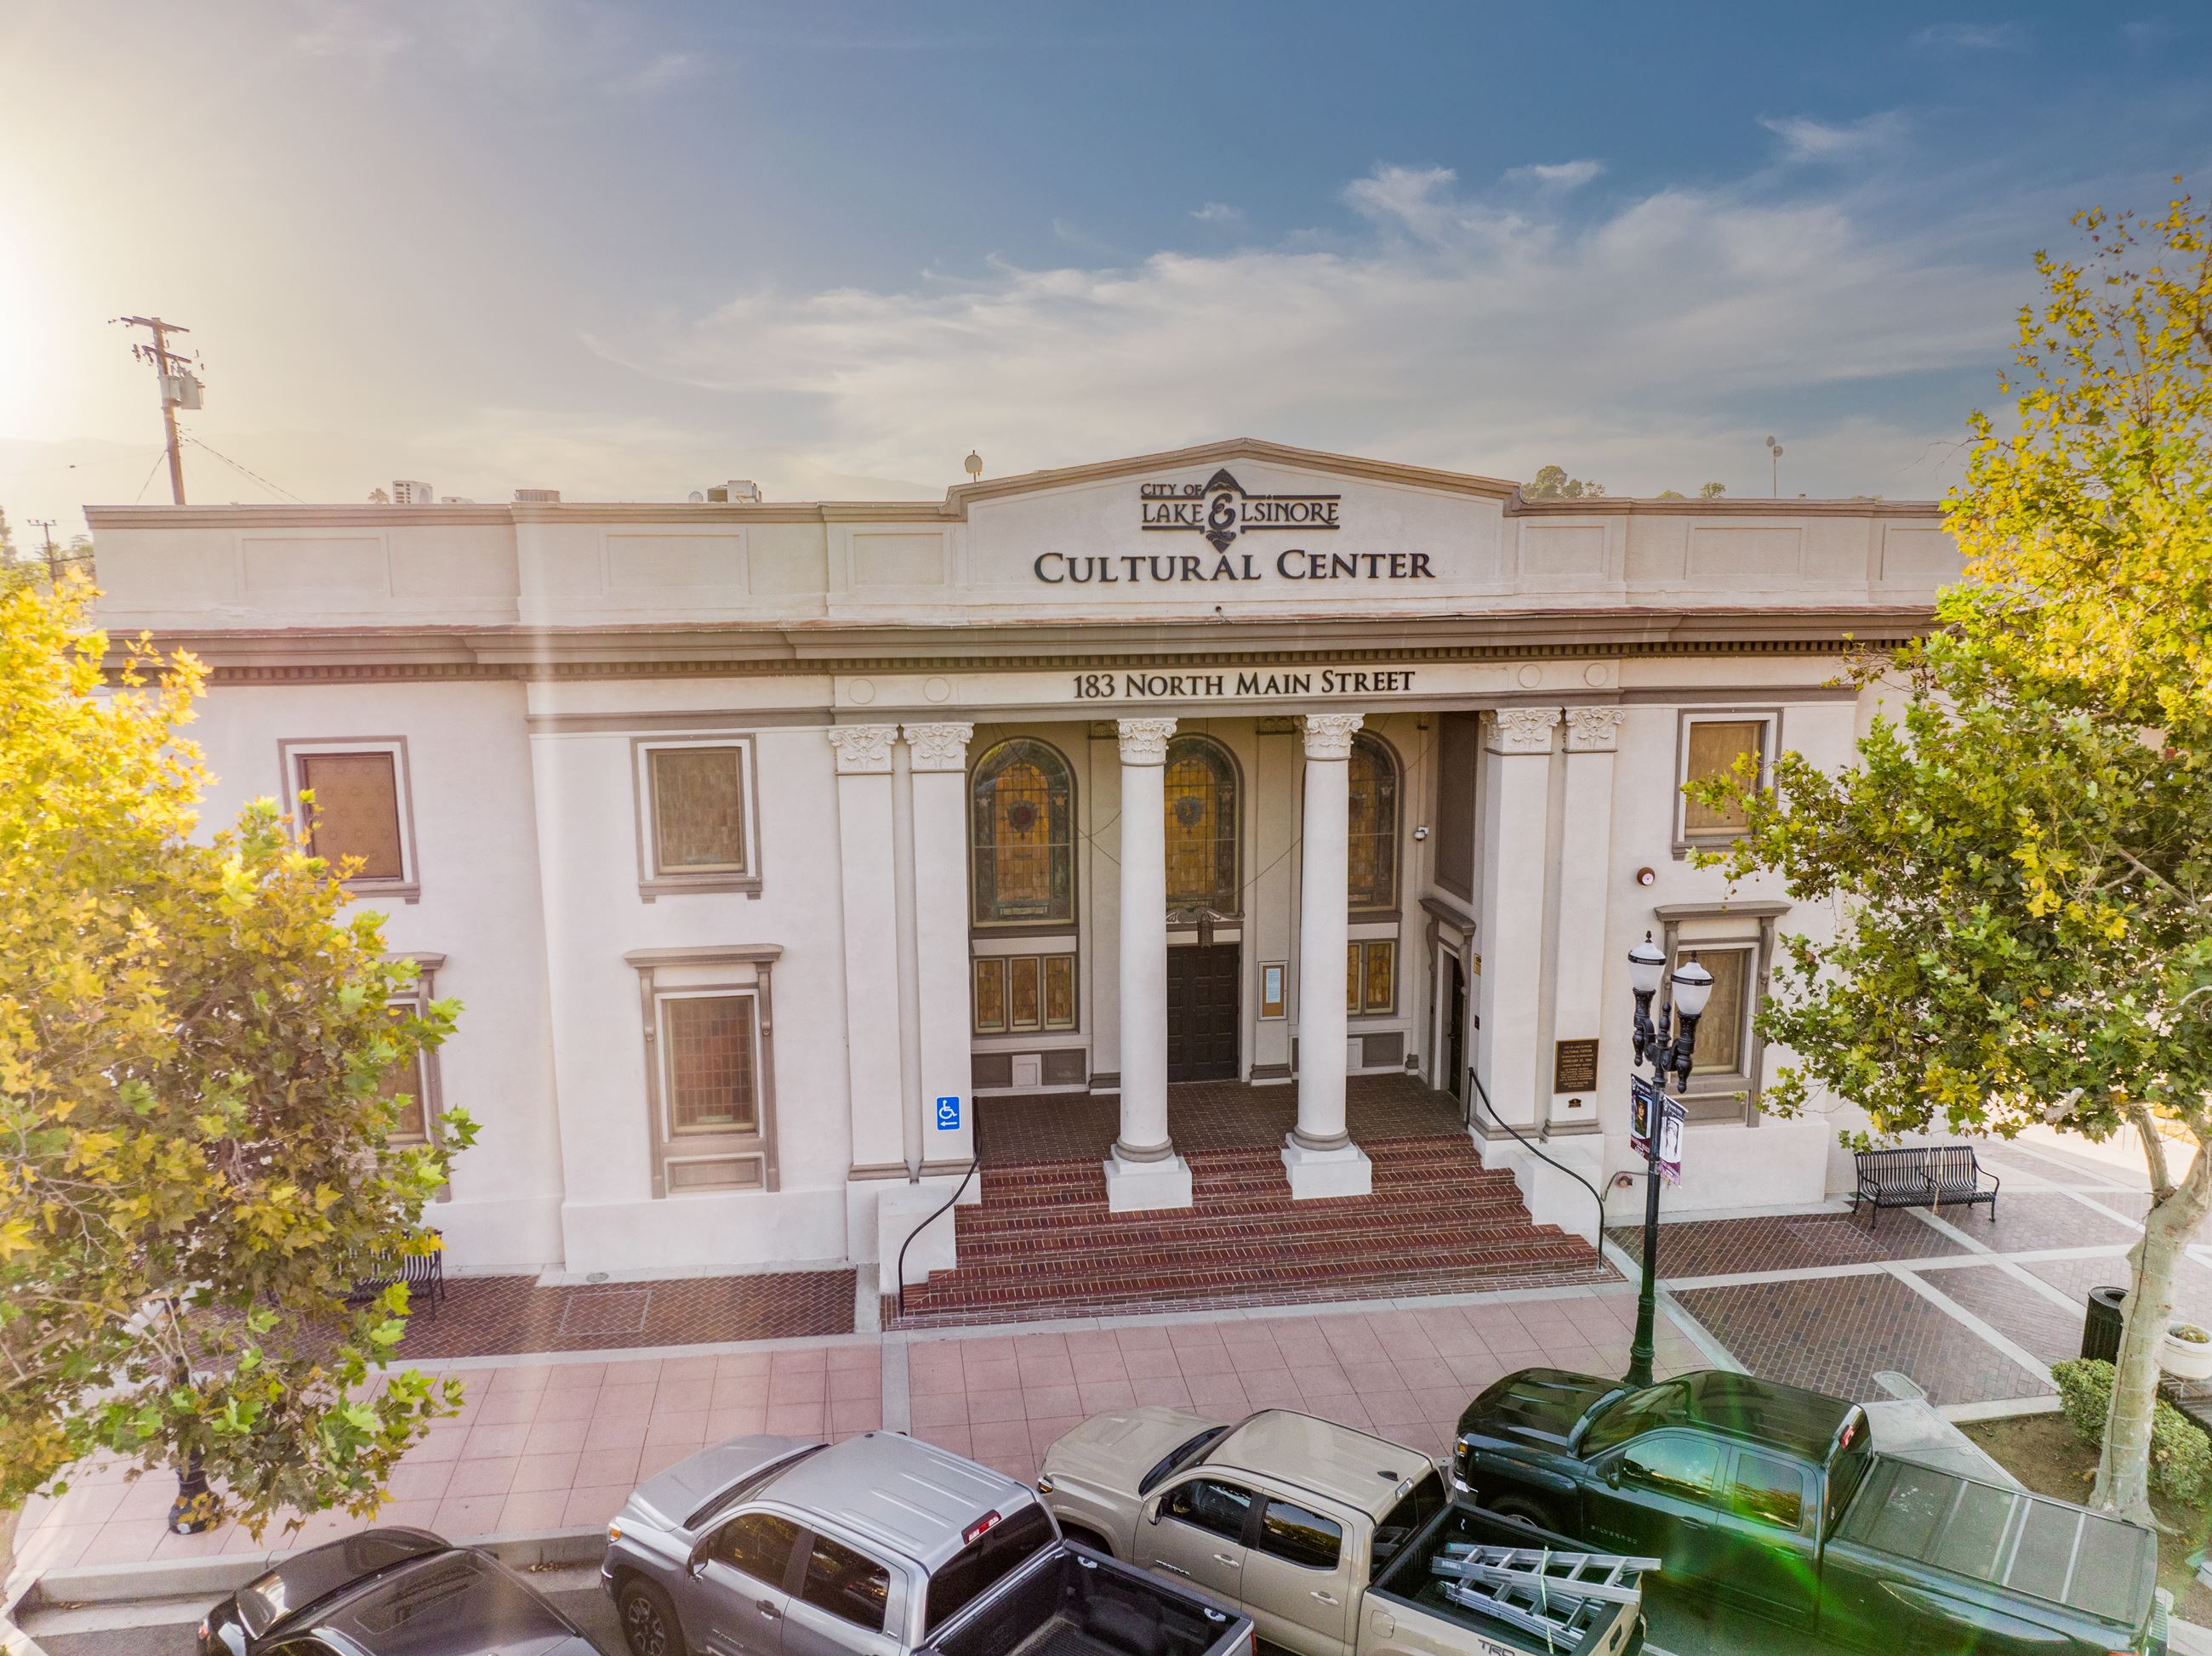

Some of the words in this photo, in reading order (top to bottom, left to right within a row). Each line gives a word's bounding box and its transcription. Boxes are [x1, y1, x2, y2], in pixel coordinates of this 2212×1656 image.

[1141, 484, 1177, 495] CITY
[1184, 484, 1202, 495] OF
[1142, 503, 1204, 525] LAKE
[1035, 552, 1262, 583] CULTURAL
[1277, 549, 1436, 579] CENTER
[1074, 674, 1115, 697] 183
[1126, 674, 1225, 697] NORTH
[1234, 672, 1311, 695] MAIN
[1322, 669, 1416, 692] STREET
